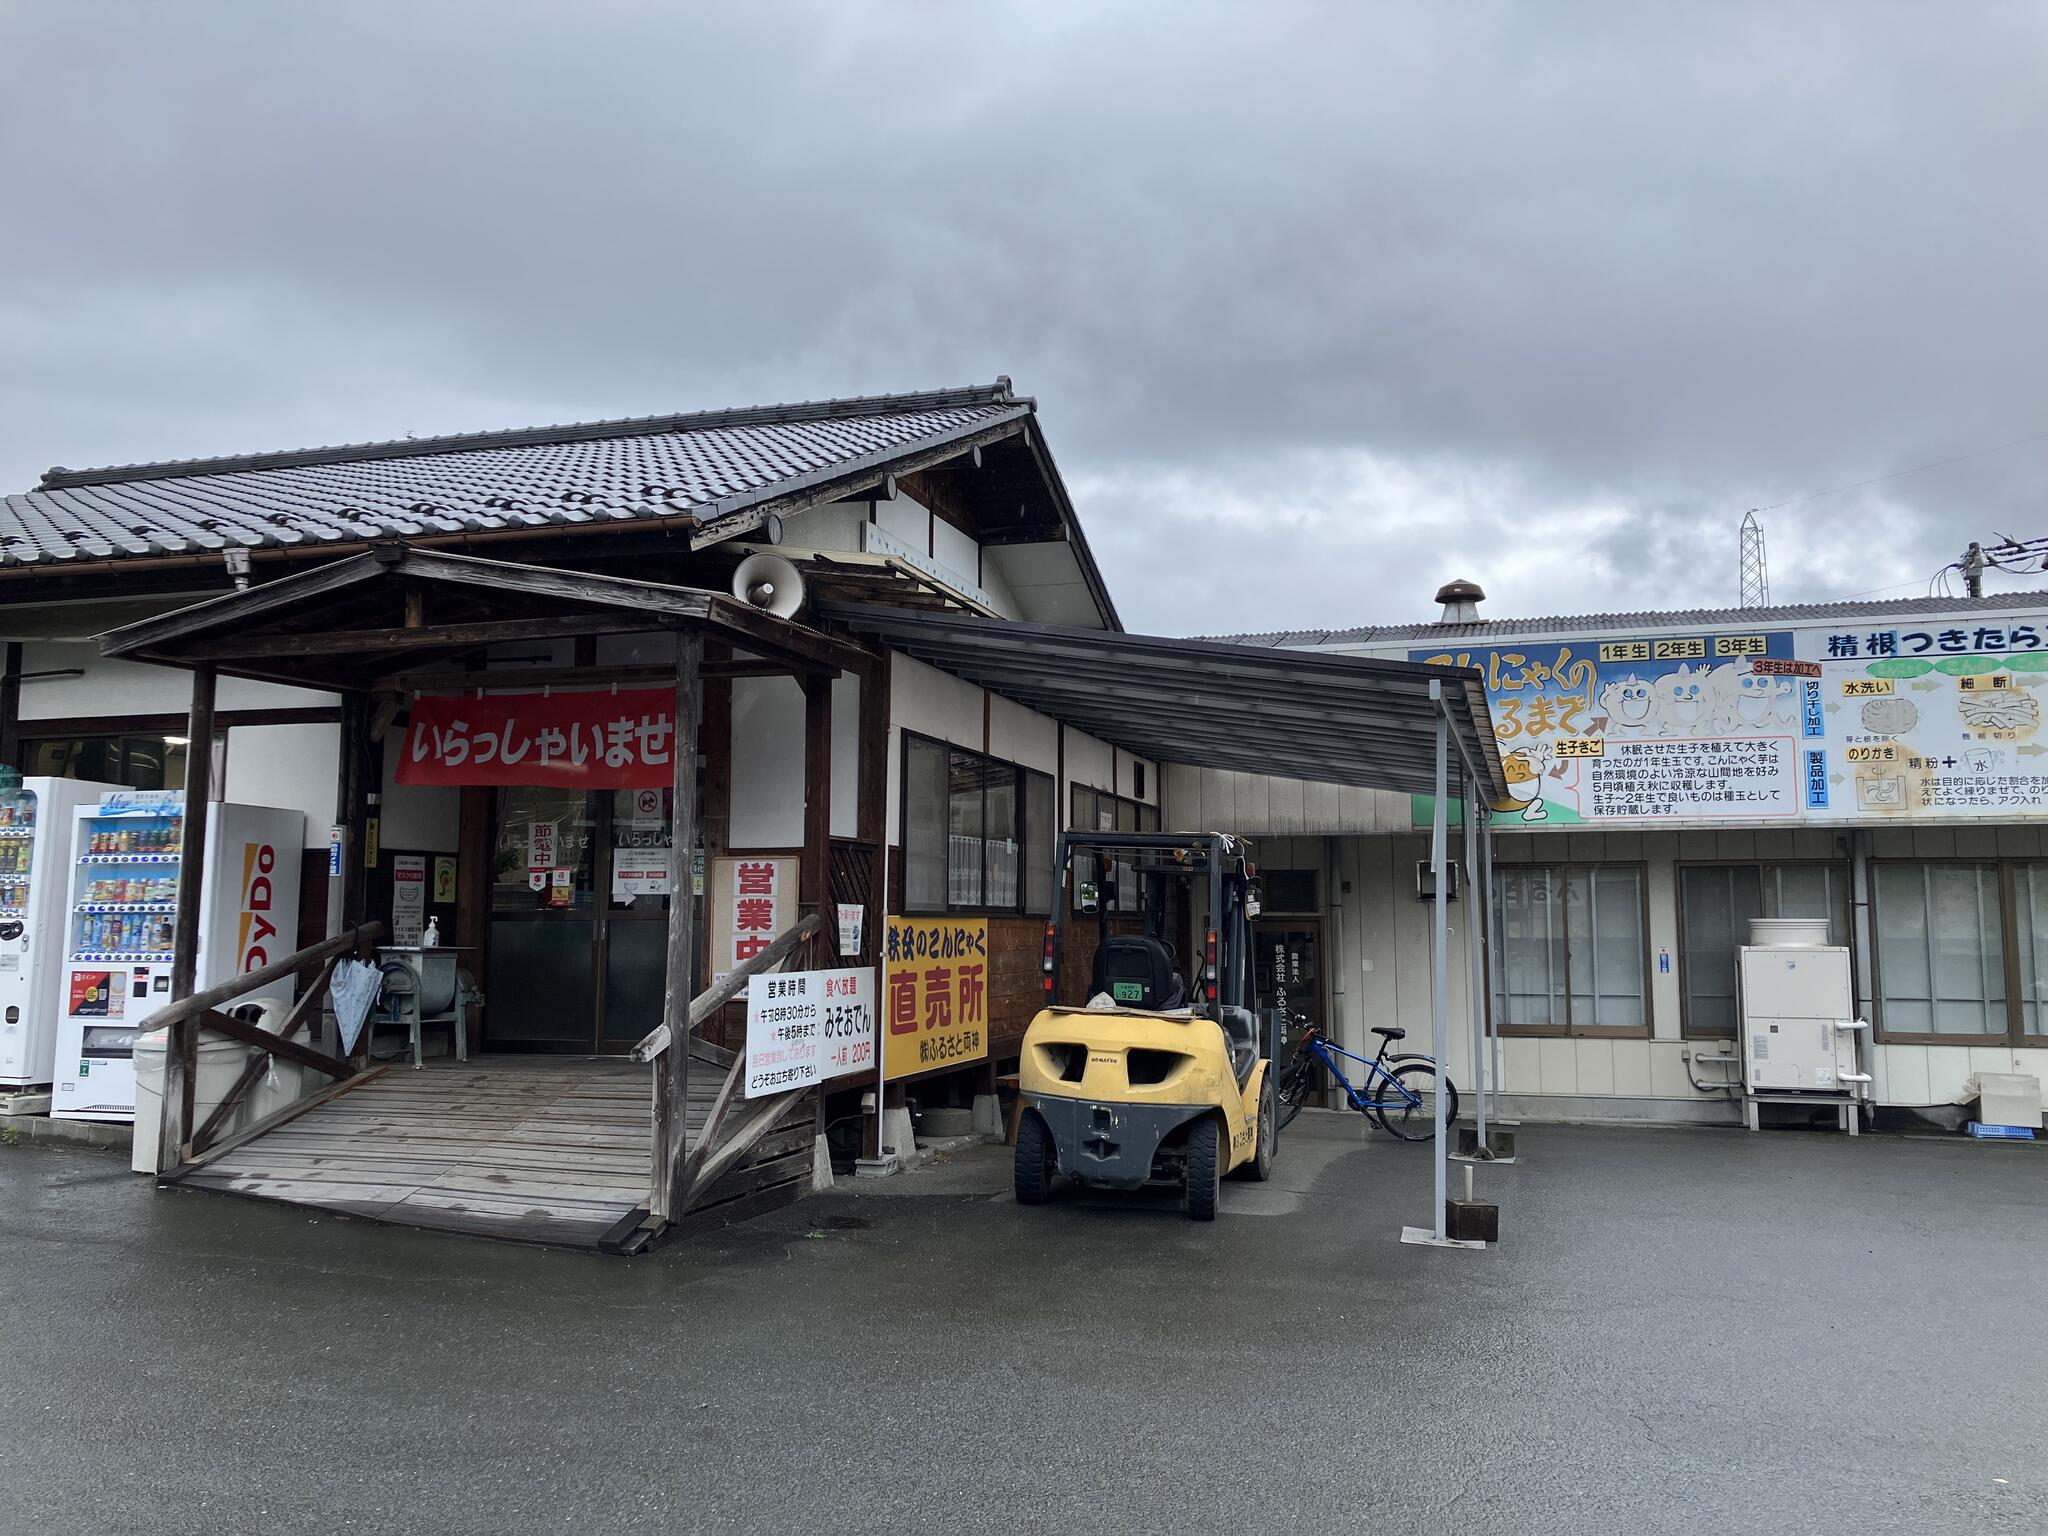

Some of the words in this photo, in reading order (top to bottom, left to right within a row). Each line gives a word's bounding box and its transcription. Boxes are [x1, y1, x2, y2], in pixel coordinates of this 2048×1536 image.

[1657, 642, 1703, 658] 2年生
[1718, 638, 1764, 654] 3年生
[1828, 626, 2048, 657] 精根つきたら
[1602, 644, 1647, 660] 1年生
[1754, 660, 1821, 677] 3年生は加工へ
[1845, 682, 1890, 694] 水洗い
[1960, 676, 2007, 690] 細断
[1806, 680, 1821, 736] 切り干し加工
[412, 713, 673, 768] いらっしゃいませ
[1556, 740, 1600, 756] 生子きご
[1620, 741, 1778, 755] 休眠させた生子を植えて大きく
[1848, 746, 1894, 760] のりかき
[1592, 765, 1779, 781] 自然環境のよい冷涼な山間地を好み
[1974, 760, 1988, 772] 水
[1809, 751, 1827, 805] 製品加工
[1594, 804, 1680, 817] 保存貯蔵します。
[736, 862, 774, 960] 営業中
[888, 925, 985, 962] 秩父のこんにゃく
[1275, 944, 1286, 982] 株式会社
[768, 978, 806, 998] 営業時間
[826, 976, 857, 998] 食べ放題
[890, 963, 984, 1036] 直売所
[760, 1004, 816, 1023] 午前8時30分から
[824, 1003, 871, 1039] みそおでん
[777, 1023, 816, 1040] 午後5時まで
[831, 1046, 848, 1067] 一人前
[852, 1041, 871, 1063] 200円
[751, 1064, 817, 1089] どうぞお立ち寄り下さい
